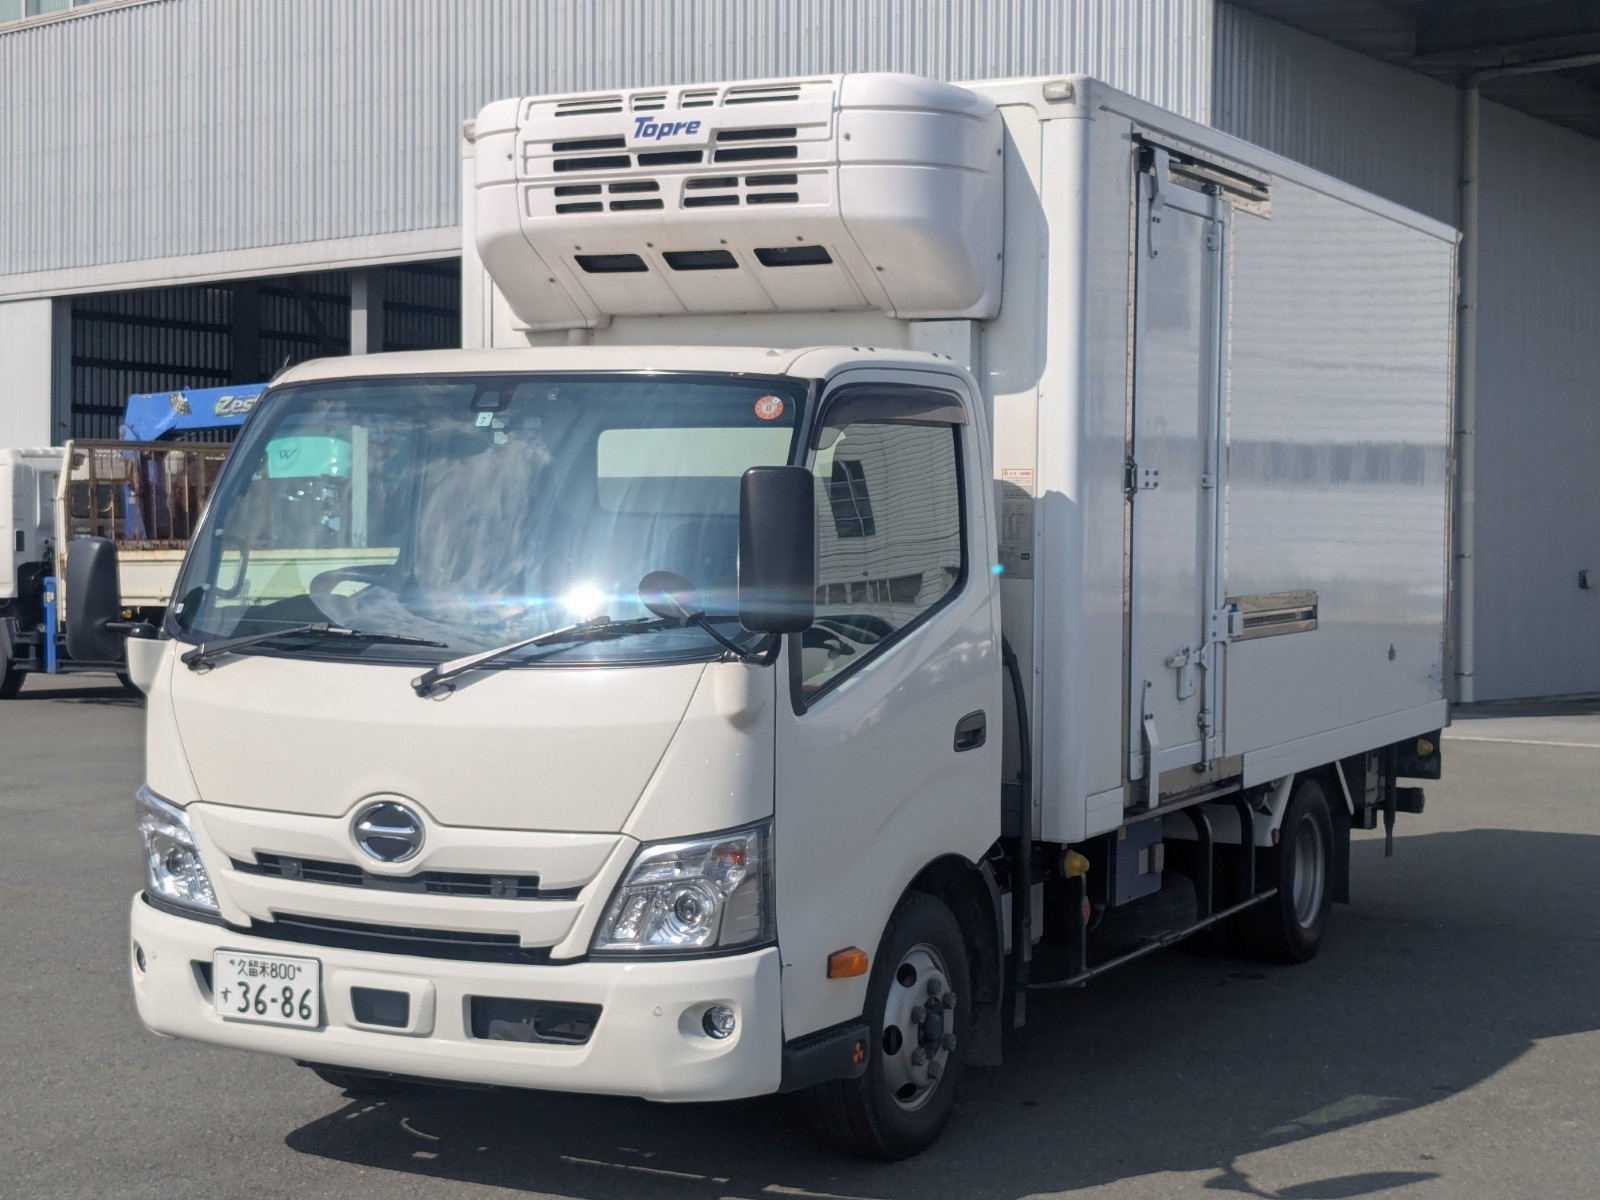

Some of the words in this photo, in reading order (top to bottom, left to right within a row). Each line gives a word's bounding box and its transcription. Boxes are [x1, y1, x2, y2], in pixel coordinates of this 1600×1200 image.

[633, 116, 702, 141] Topre
[220, 987, 232, 1004] す
[237, 981, 312, 1020] 36-86
